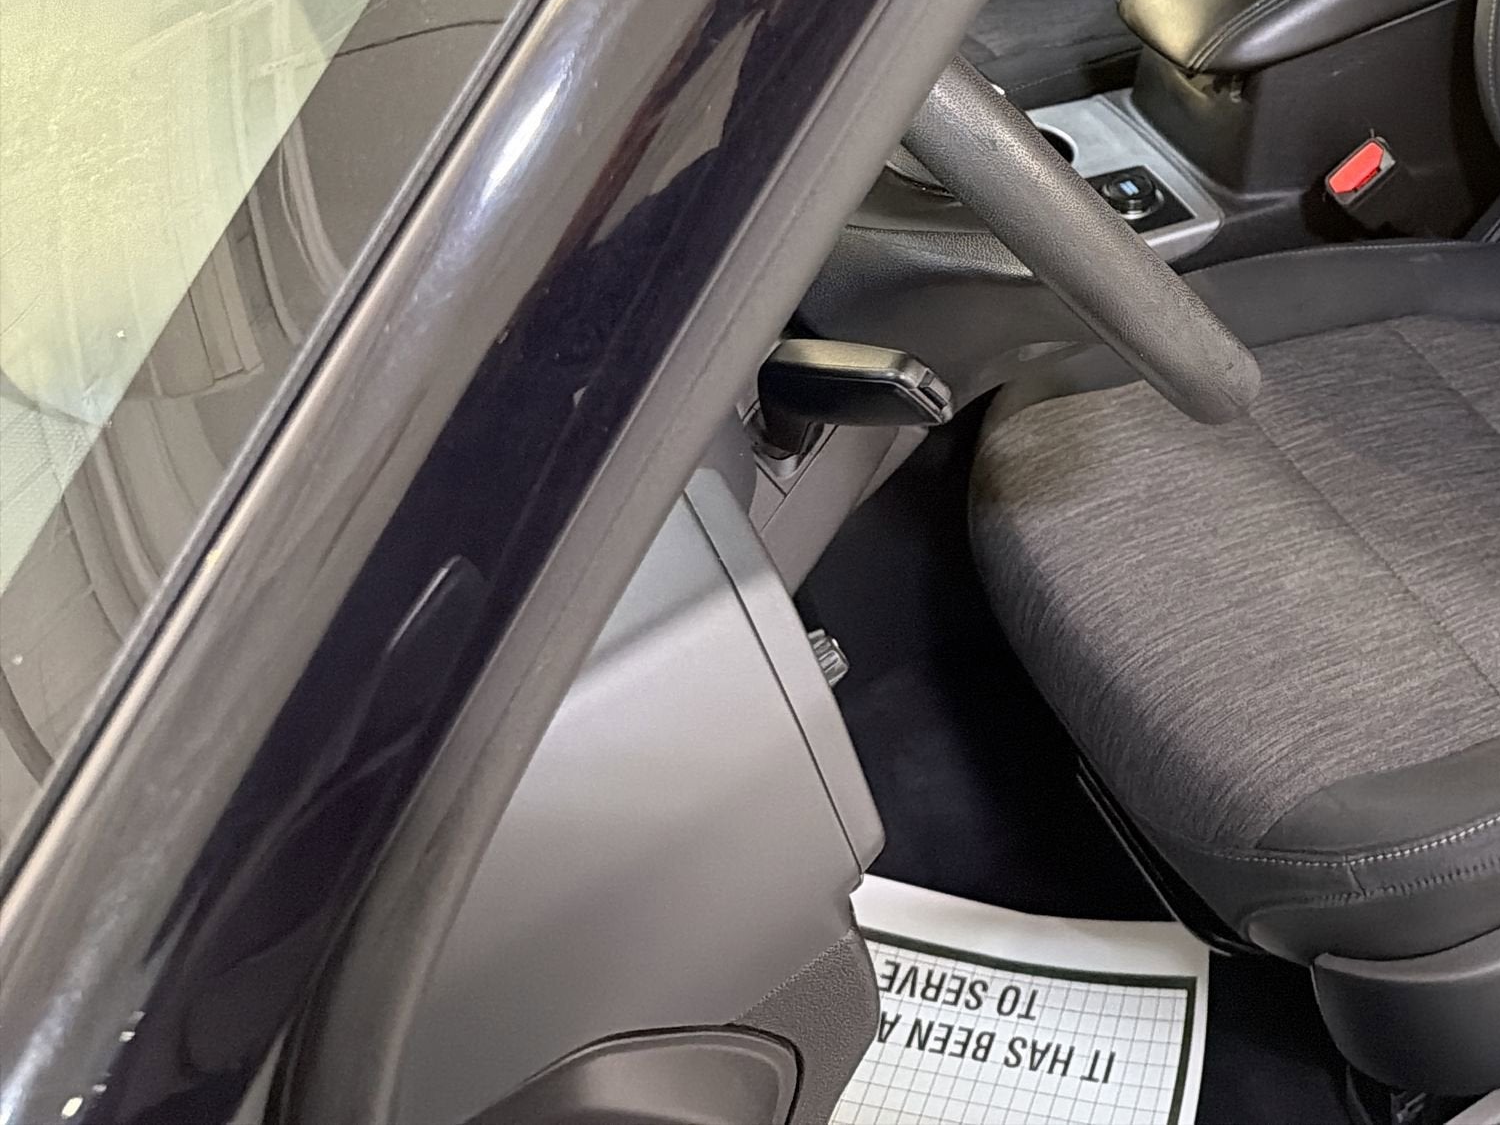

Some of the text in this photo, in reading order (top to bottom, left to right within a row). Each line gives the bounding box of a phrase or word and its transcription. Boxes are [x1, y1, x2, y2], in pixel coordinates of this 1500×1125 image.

[878, 959, 1039, 1020] TO SERVE
[877, 1011, 1117, 1084] IT HAS BEEN A
